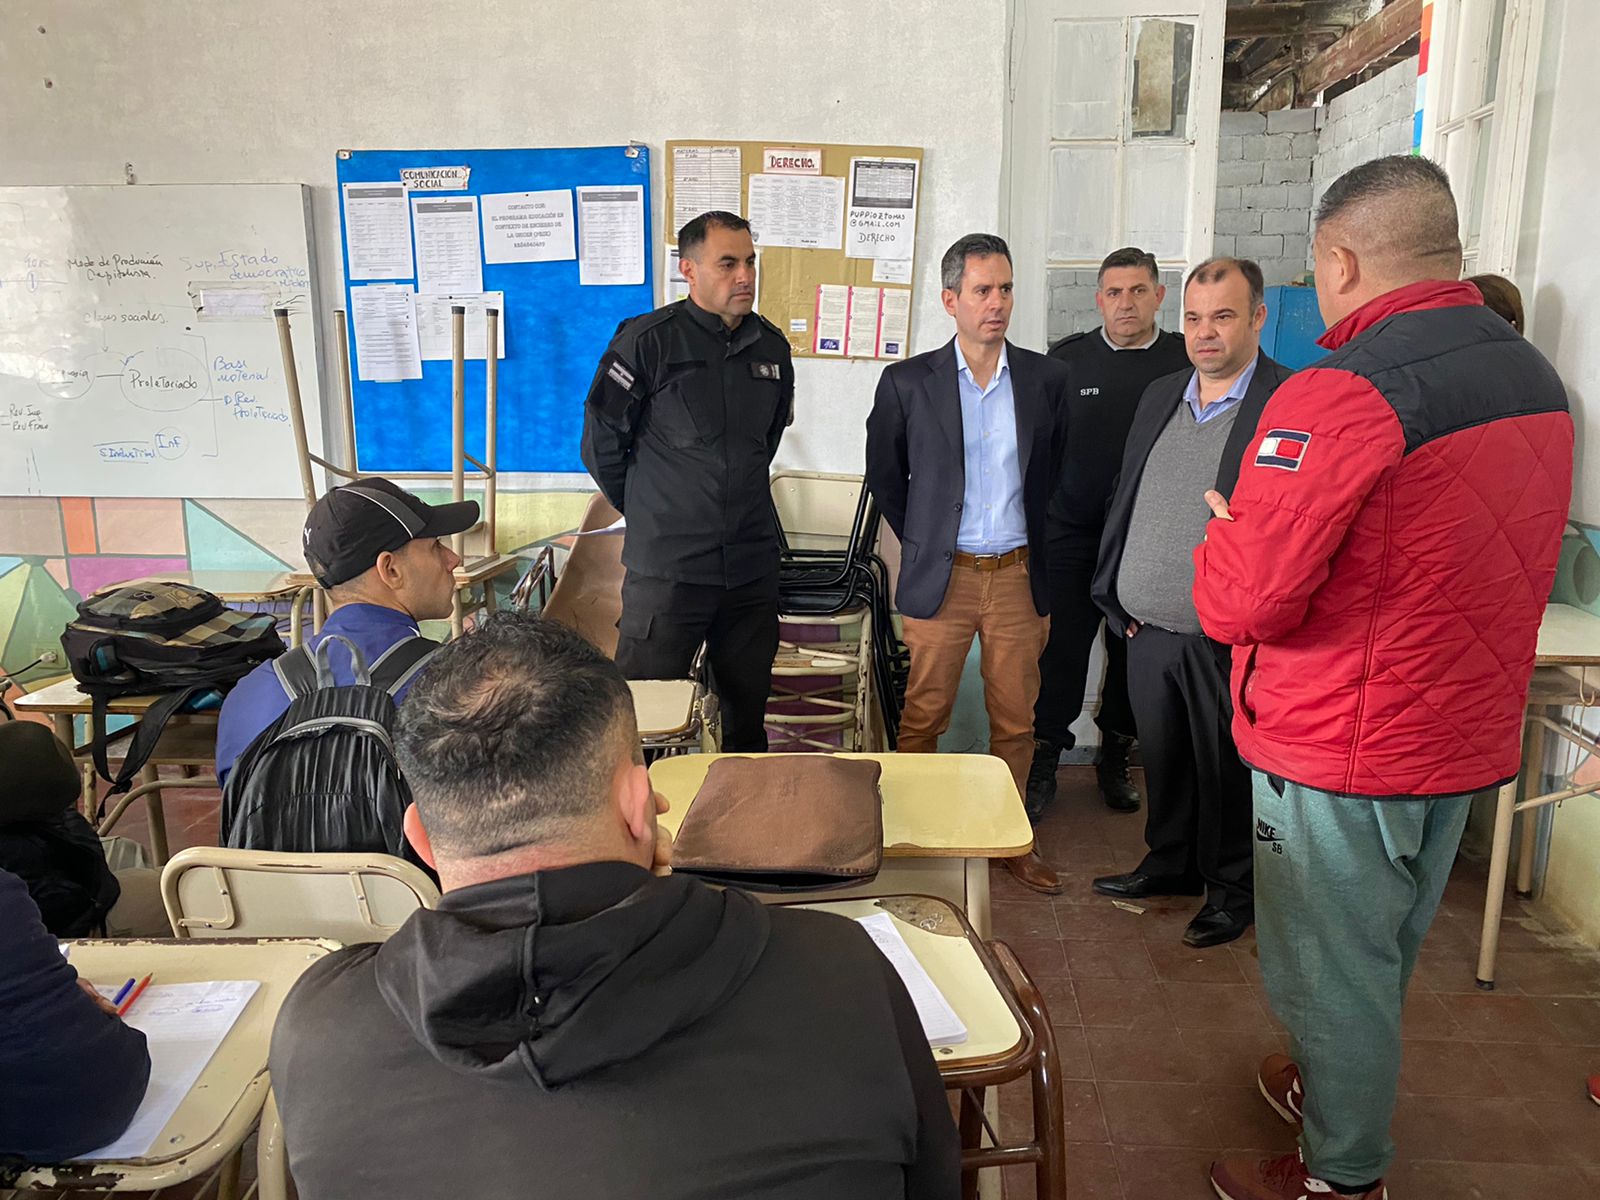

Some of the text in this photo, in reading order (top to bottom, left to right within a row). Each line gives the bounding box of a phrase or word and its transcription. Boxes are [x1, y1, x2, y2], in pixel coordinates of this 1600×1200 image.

[413, 179, 442, 188] SOCIAL
[857, 232, 895, 245] DERECHO
[1080, 387, 1099, 396] SPB
[1256, 817, 1277, 838] NIKE
[1272, 842, 1283, 855] SB
